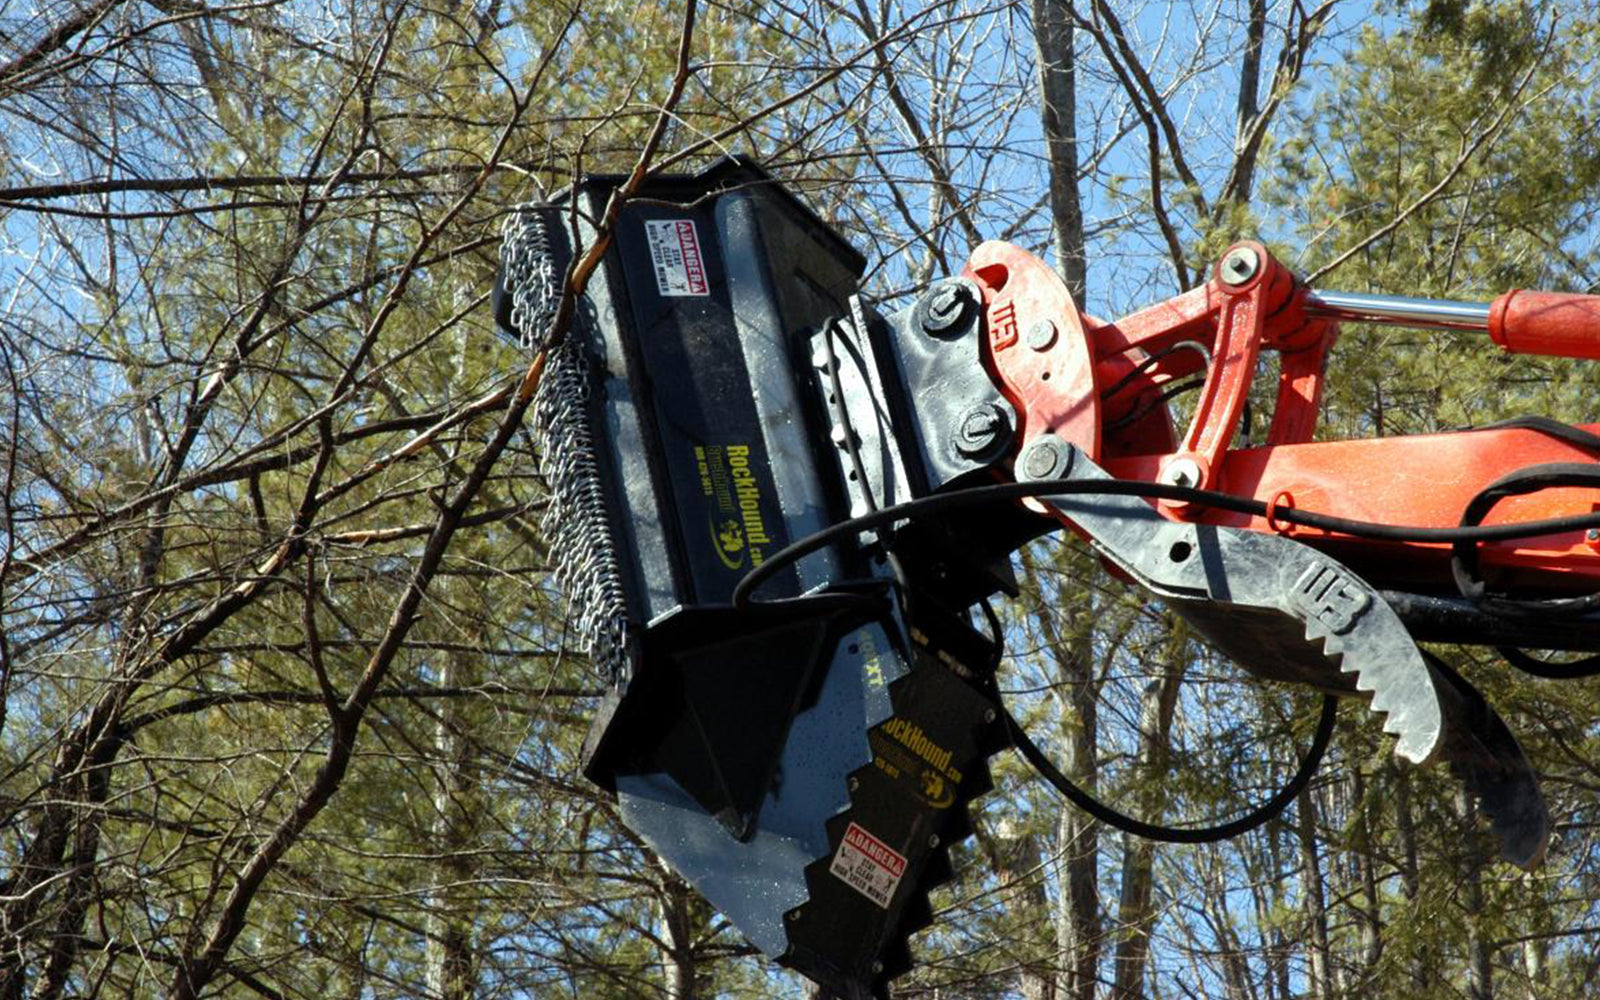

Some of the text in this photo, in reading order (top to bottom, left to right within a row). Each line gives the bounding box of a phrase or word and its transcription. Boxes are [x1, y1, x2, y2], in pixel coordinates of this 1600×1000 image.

[648, 224, 670, 292] HIGH SPEED MOWER
[662, 247, 674, 268] CLEAR
[672, 248, 682, 265] STAY
[681, 232, 702, 281] DANGER
[856, 833, 896, 870] DANGER
[861, 858, 877, 872] STAY
[833, 863, 887, 903] HIGH SPEED MOWER
[855, 866, 874, 881] CLEAR
